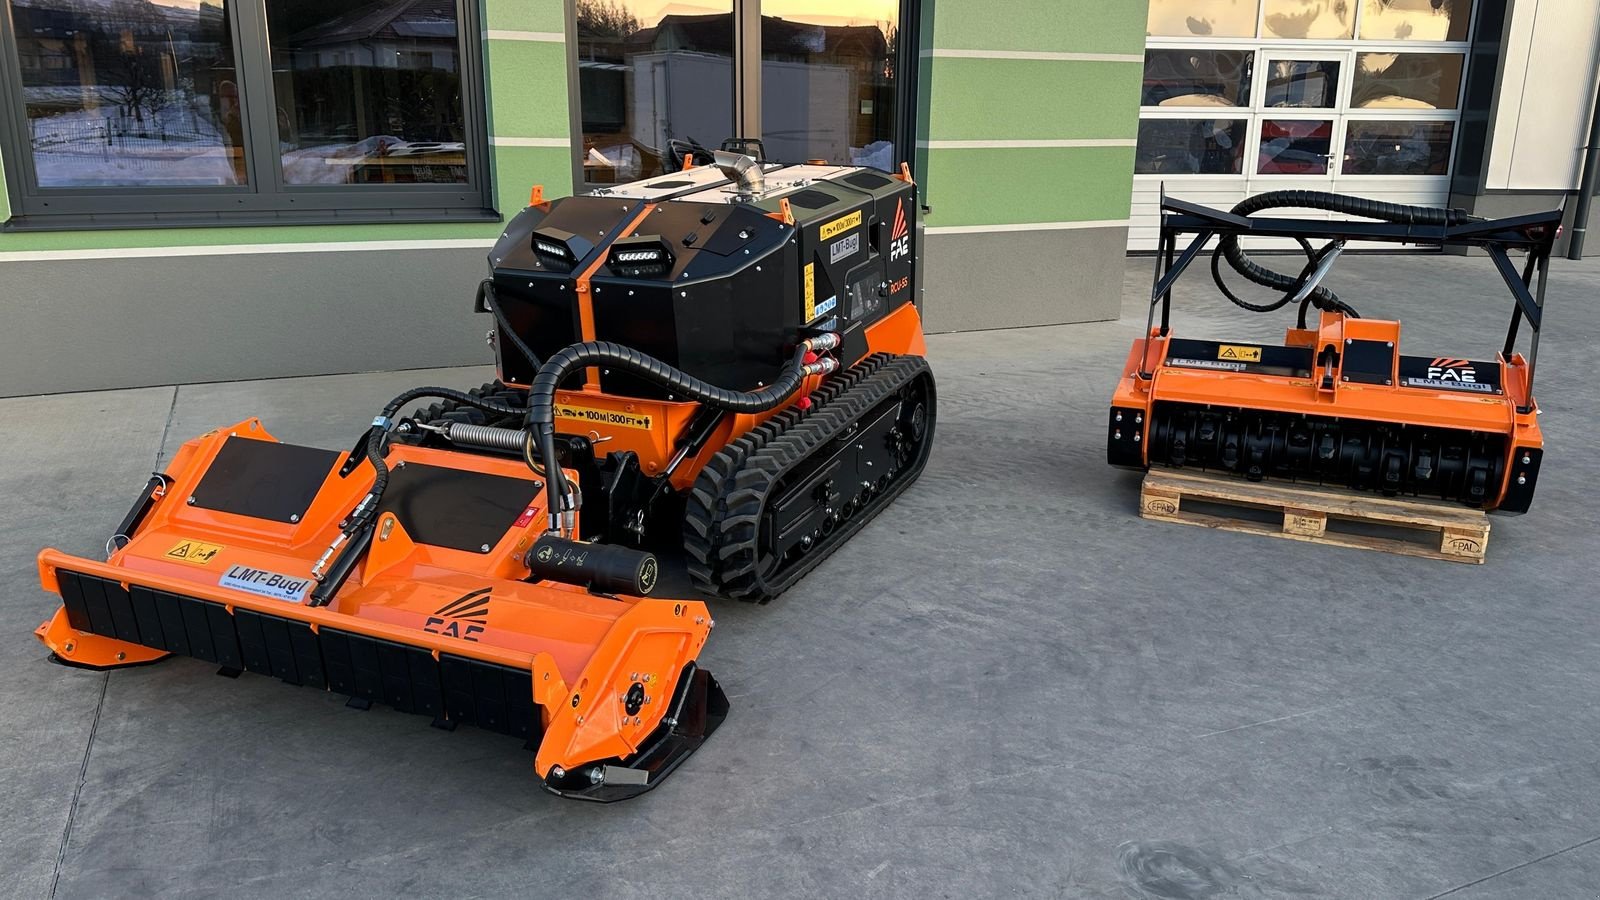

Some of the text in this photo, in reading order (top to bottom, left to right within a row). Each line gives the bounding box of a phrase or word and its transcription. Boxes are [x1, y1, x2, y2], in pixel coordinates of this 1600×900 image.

[832, 234, 857, 256] LMT-Bugl
[890, 236, 909, 262] FAE
[890, 276, 908, 295] RCU-55
[1428, 367, 1476, 383] FAE
[228, 566, 309, 595] LMT-Bugl
